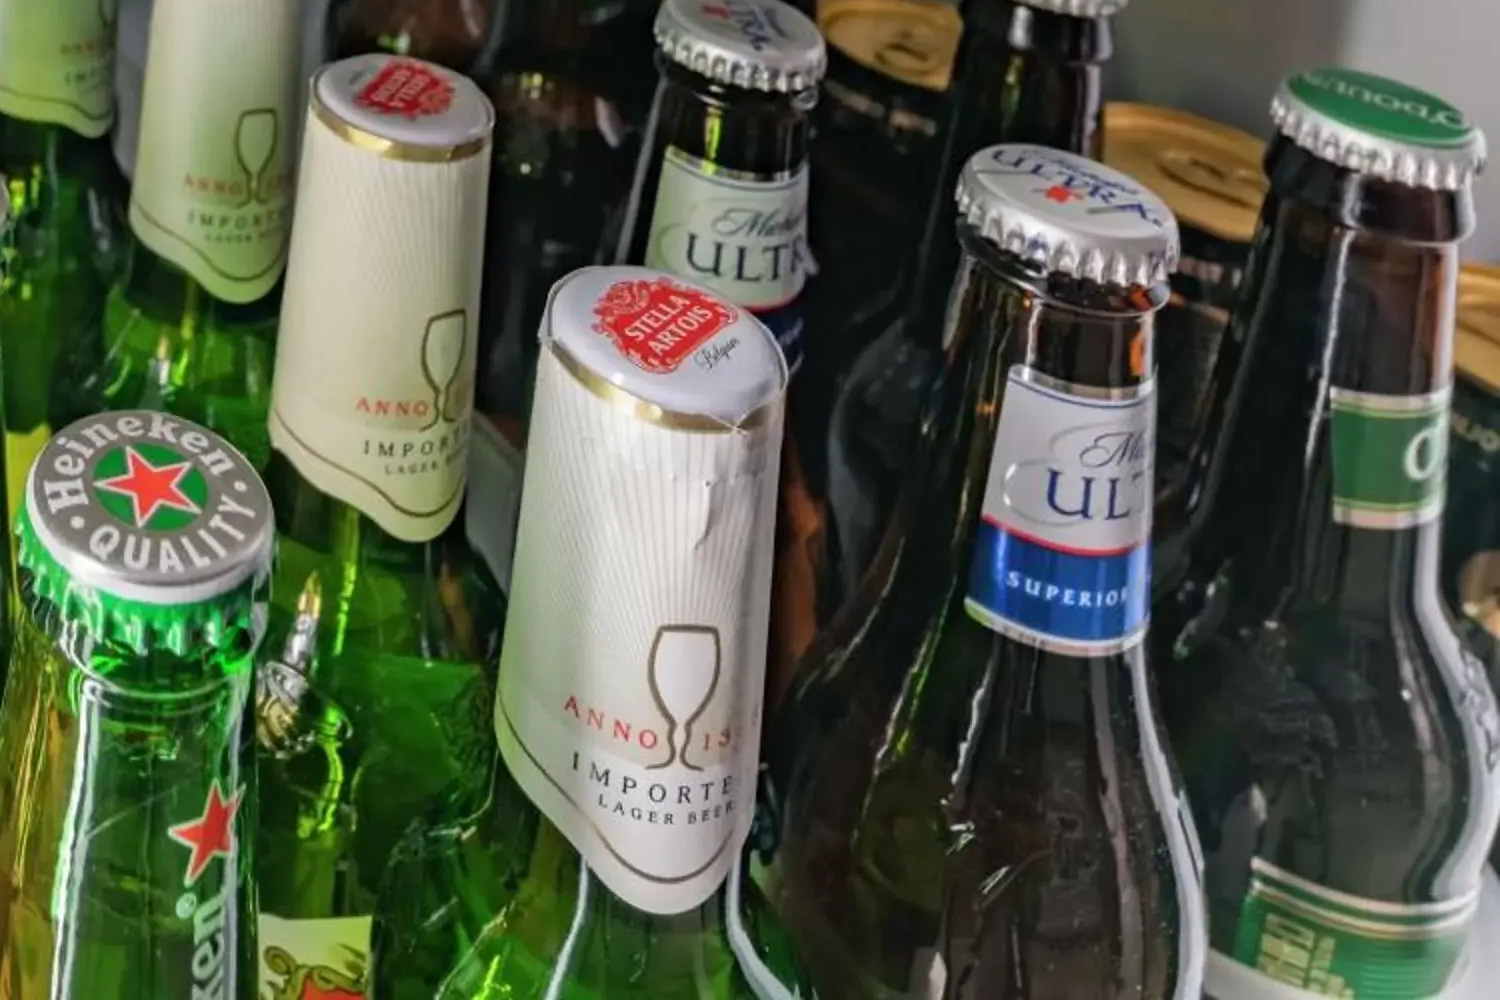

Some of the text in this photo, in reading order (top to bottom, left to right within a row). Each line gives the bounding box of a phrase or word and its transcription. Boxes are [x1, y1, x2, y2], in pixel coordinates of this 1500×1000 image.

[623, 293, 693, 343] STELLA
[646, 304, 714, 358] ARTOIS
[355, 396, 431, 418] ANNO
[43, 412, 236, 515] Heineken
[89, 493, 257, 574] QUALITY
[562, 694, 659, 751] ANNO
[571, 750, 736, 806] IMPORTE
[597, 792, 737, 827] LAGER BEER
